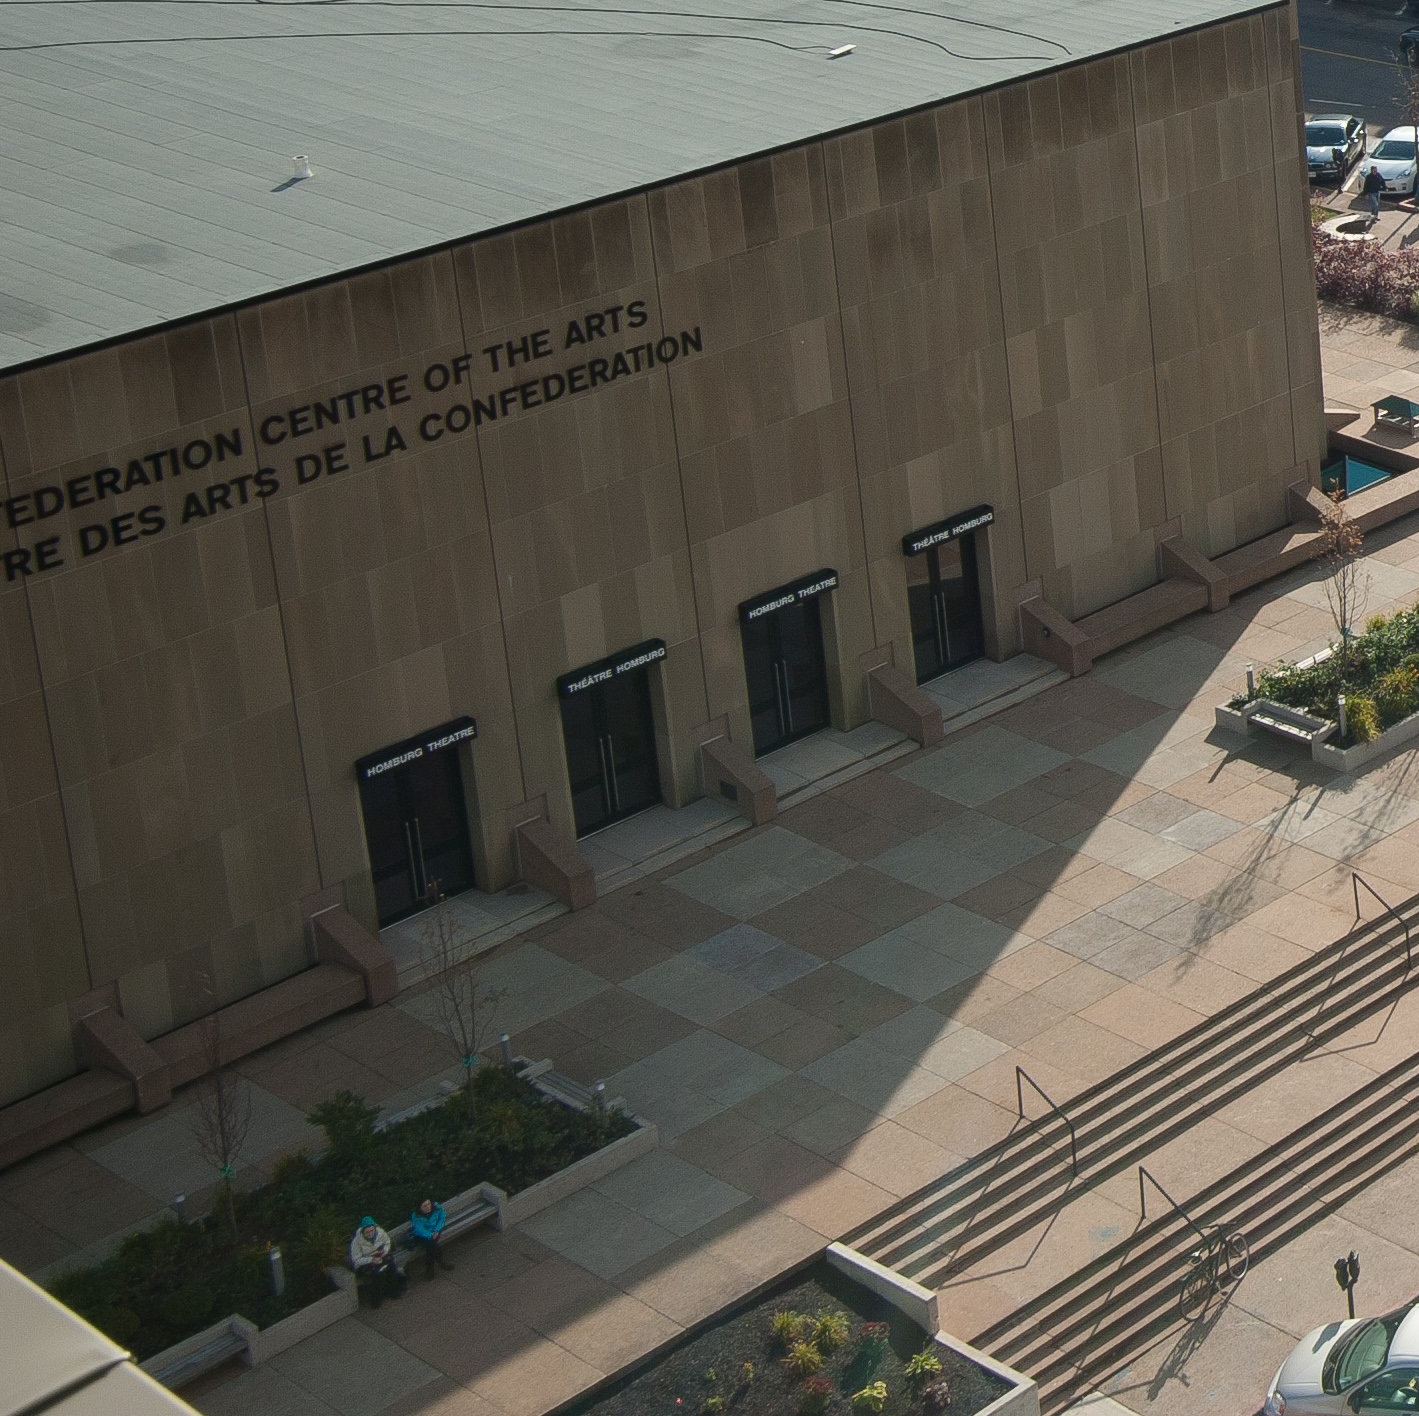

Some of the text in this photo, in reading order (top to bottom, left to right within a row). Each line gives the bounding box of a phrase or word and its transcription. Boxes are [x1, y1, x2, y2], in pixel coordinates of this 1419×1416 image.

[0, 300, 648, 529] EDERATION CENTRE OF THE ARTS
[79, 505, 166, 558] DES
[181, 467, 281, 525] ARTS
[295, 443, 350, 485] DE
[362, 425, 407, 463] LA
[419, 326, 704, 442] CONFEDERATION
[952, 512, 993, 536] HOMBURG
[749, 576, 837, 619] HOMBURG THEATRE
[616, 647, 665, 675] HOMBURG
[367, 726, 475, 778] HOMBURG THEATRE
